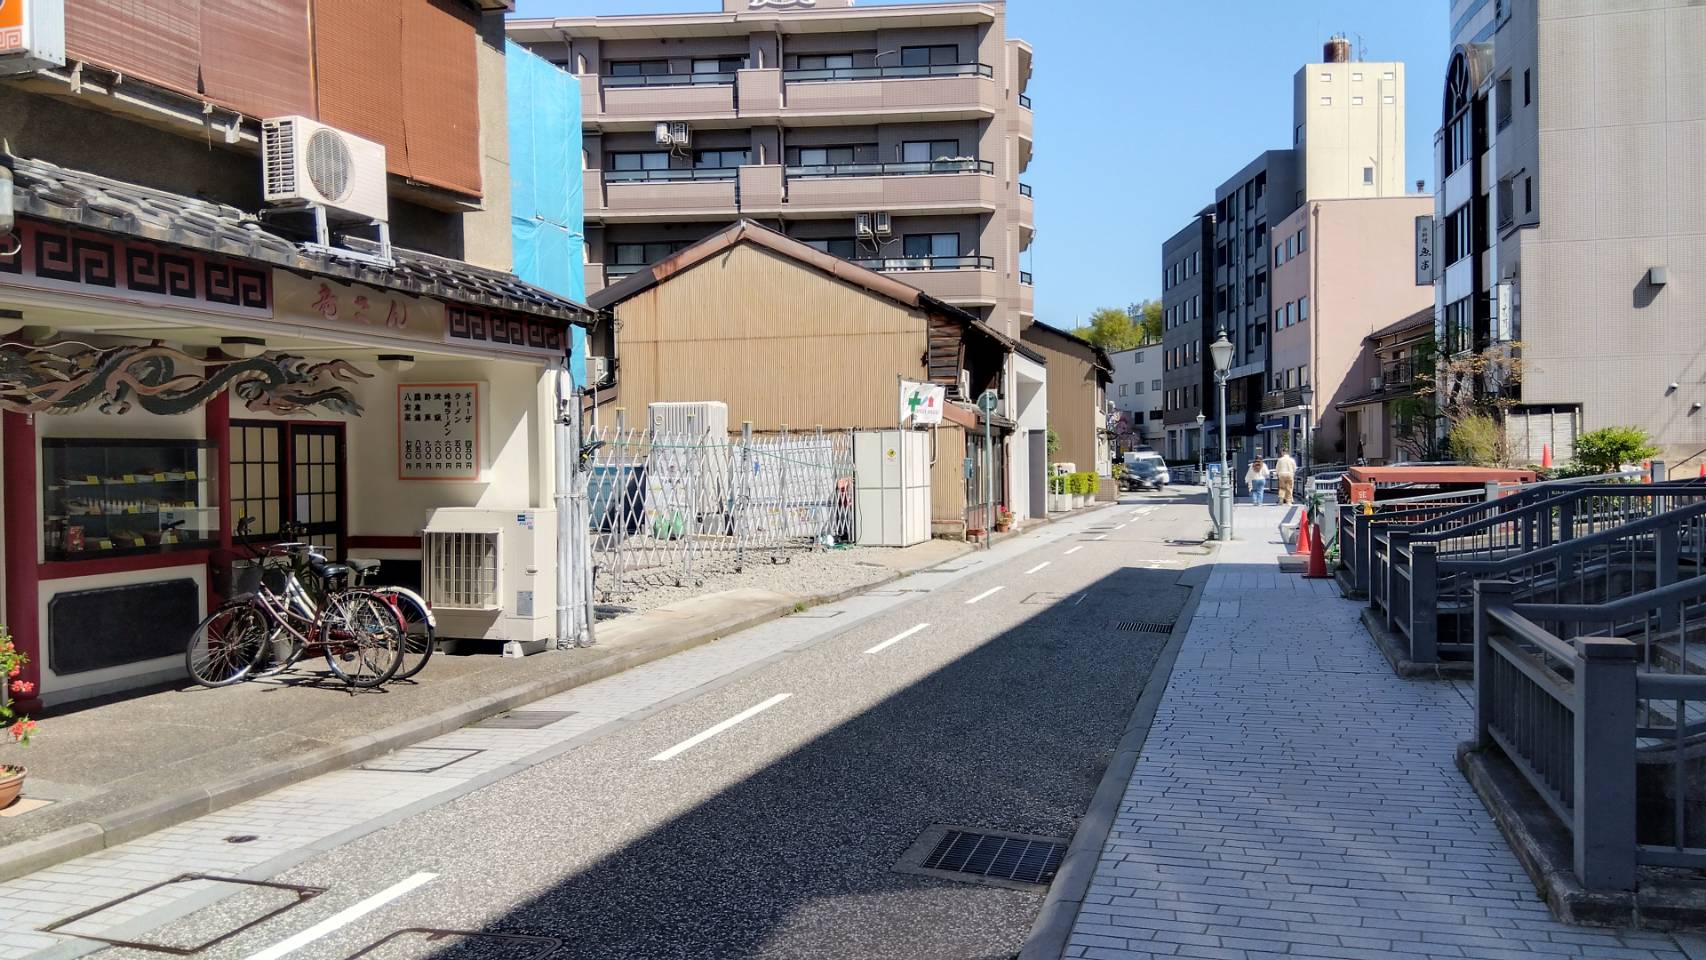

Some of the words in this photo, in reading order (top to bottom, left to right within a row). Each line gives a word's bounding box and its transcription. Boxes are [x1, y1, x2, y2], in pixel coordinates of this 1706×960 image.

[444, 393, 452, 436] 味噌ラーメン
[454, 393, 462, 423] ラーメン
[464, 392, 472, 423] ギョーザ
